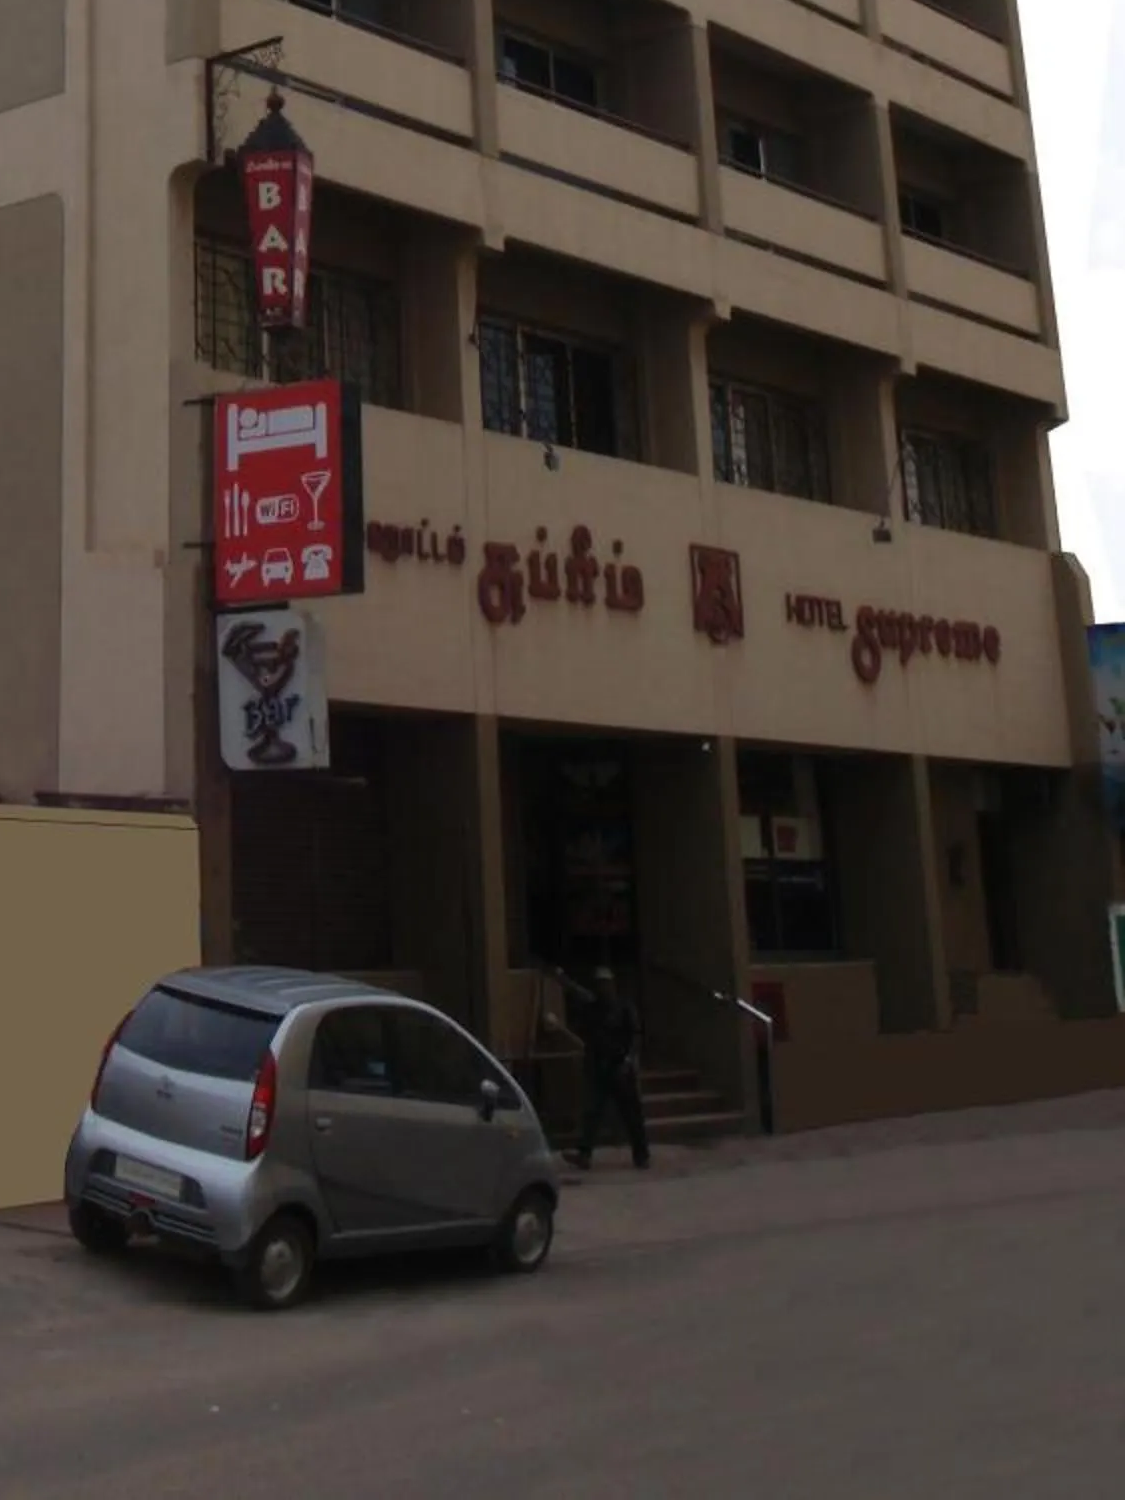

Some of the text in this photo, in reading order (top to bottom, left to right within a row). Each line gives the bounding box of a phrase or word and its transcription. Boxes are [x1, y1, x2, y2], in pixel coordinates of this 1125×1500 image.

[258, 181, 289, 296] BAR
[786, 592, 1001, 684] HOTEL Supreme
